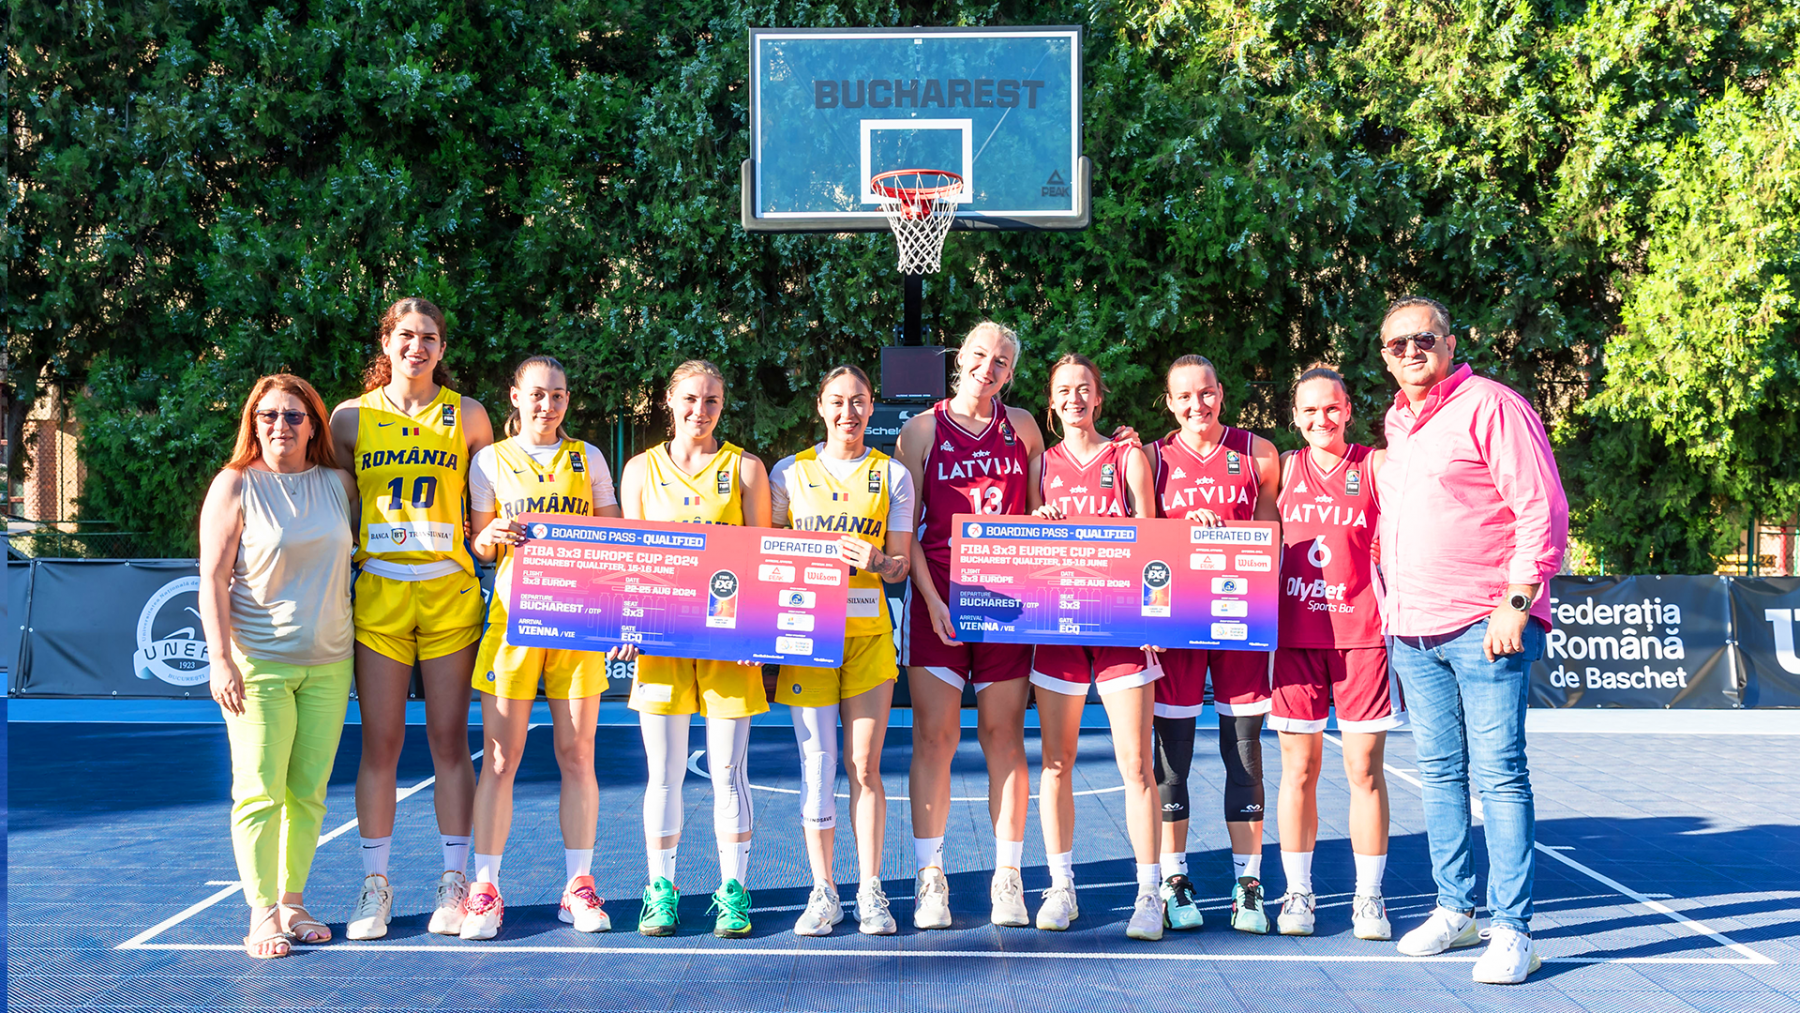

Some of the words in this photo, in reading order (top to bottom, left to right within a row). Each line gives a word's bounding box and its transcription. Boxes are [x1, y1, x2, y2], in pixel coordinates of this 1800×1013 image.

[813, 79, 1045, 110] BUCHAREST
[1041, 186, 1070, 197] PEAK
[361, 446, 458, 471] ROMÂNIA
[938, 457, 1024, 481] LATVIJA
[387, 476, 438, 511] 10
[1161, 485, 1249, 511] LATVIJA
[504, 492, 589, 519] ROMÂNIA
[968, 486, 1004, 515] 13
[1045, 496, 1123, 516] TVIJA
[1283, 503, 1368, 528] LATVIJA
[795, 512, 882, 537] ROMÂNIA
[370, 532, 389, 540] BANCA
[551, 527, 607, 541] BOARDING
[608, 531, 636, 543] PASS
[643, 533, 704, 547] QUALIFIED
[986, 526, 1040, 538] BOARDING
[1041, 528, 1069, 538] PASS
[1075, 528, 1135, 540] QUALIFIED
[1193, 530, 1251, 541] OPERATED
[1254, 531, 1269, 541] BY
[763, 540, 822, 554] OPERATED
[960, 544, 990, 555] FIBA
[992, 545, 1017, 555] 3x3
[1018, 545, 1068, 557] EUROPE
[1069, 547, 1096, 558] CUP
[1097, 548, 1131, 558] 2024
[1307, 535, 1332, 568] 6
[523, 545, 554, 557] FIBA
[556, 547, 582, 559] 3x3
[583, 549, 634, 562] EUROPE
[636, 552, 663, 564] CUP
[664, 554, 699, 567] 2024
[960, 555, 1012, 565] BUCHAREST
[1012, 557, 1061, 567] QUALIFIER,
[1062, 558, 1086, 566] 15-16
[1086, 559, 1108, 567] JUNE
[522, 557, 576, 568] BUCHAREST
[576, 560, 626, 571] QUALIFIER,
[627, 564, 652, 573] 15-16
[652, 566, 675, 575] JUNE
[1238, 559, 1268, 568] Wilson
[522, 569, 544, 577] FLIGHT
[807, 571, 837, 582] Wilson
[960, 574, 978, 583] 3x3
[979, 575, 1014, 584] EUROPE
[522, 577, 541, 586] 3x3
[541, 578, 577, 588] EUROPE
[1087, 579, 1105, 587] AUG
[1106, 580, 1131, 588] 2024
[1286, 576, 1347, 602] OlyBet
[520, 593, 553, 601] DEPARTURE
[624, 585, 651, 594] 22-25
[652, 586, 671, 595] AUG
[672, 588, 697, 597] 2024
[519, 600, 584, 613] BUCHAREST
[960, 597, 1022, 608] BUCHAREST
[1059, 601, 1080, 610] 3x3
[1307, 600, 1337, 613] Sports
[1338, 603, 1355, 613] Bar
[622, 607, 644, 618] 3x3
[518, 625, 559, 637] VIENNA
[959, 621, 999, 631] VIENNA
[1059, 624, 1080, 635] ECQ
[621, 632, 642, 644] ECQ
[1545, 627, 1685, 660] Română
[179, 661, 196, 669] 1923
[1550, 664, 1580, 688] de
[1586, 665, 1688, 689] Baschet
[803, 815, 833, 823] LINDSAVE
